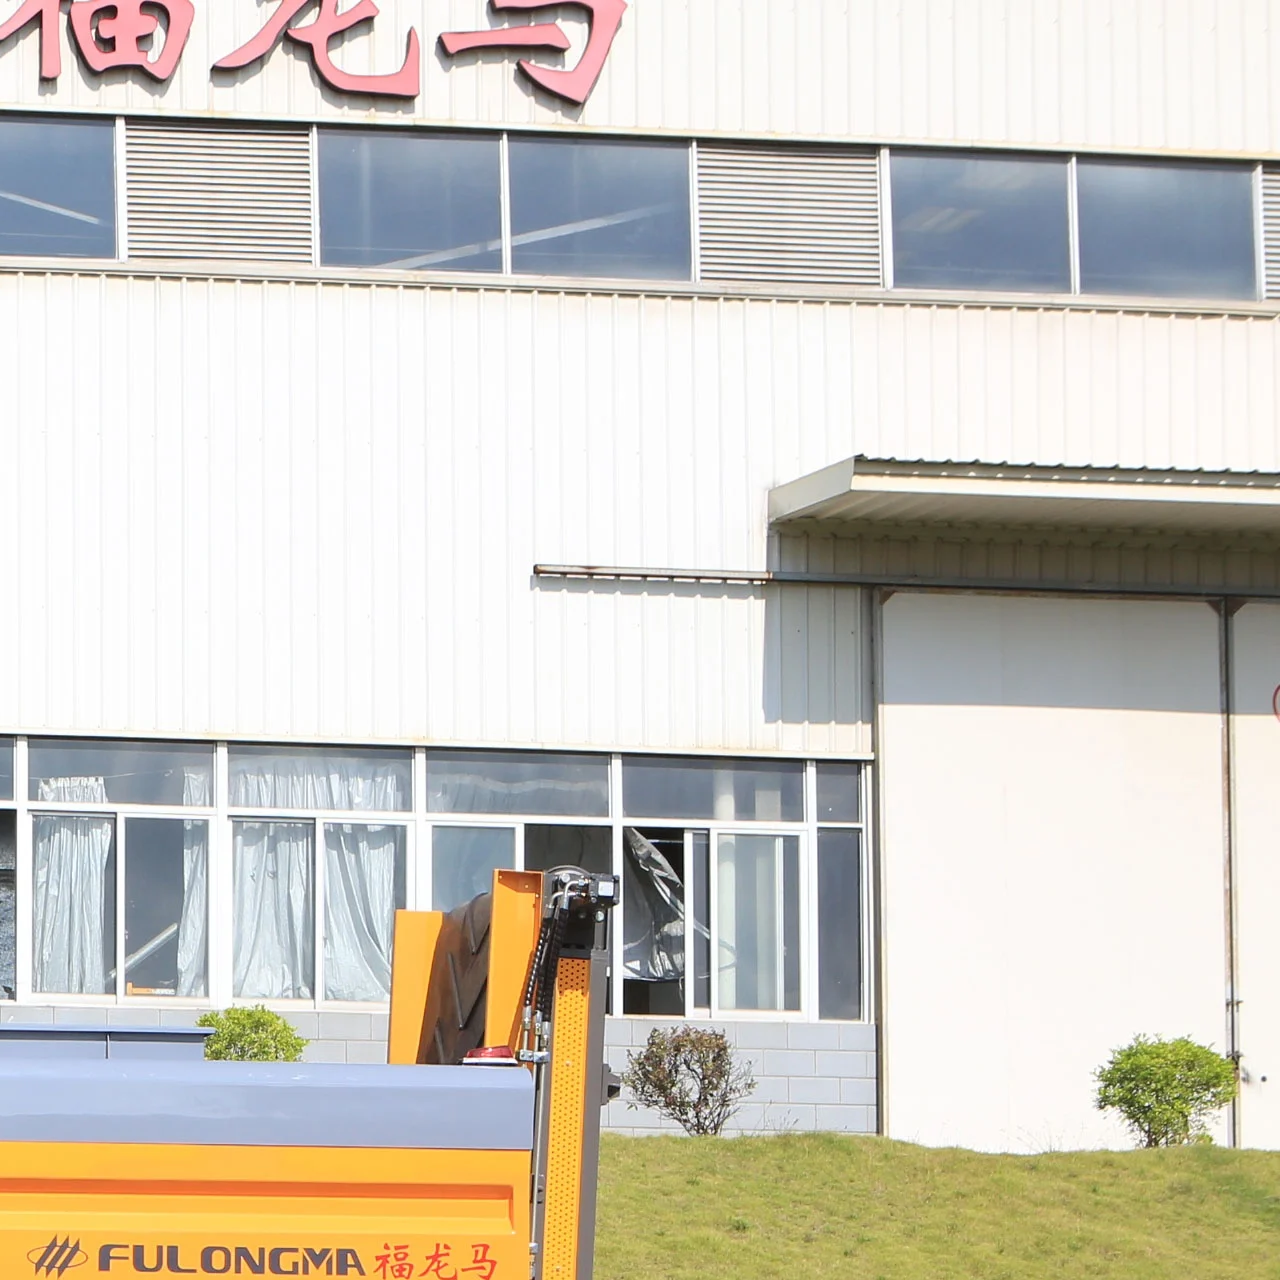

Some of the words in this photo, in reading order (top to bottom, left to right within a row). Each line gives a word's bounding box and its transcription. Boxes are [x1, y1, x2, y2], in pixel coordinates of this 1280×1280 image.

[97, 1243, 366, 1276] FULONGMA
[373, 1242, 498, 1280] 福龙马
